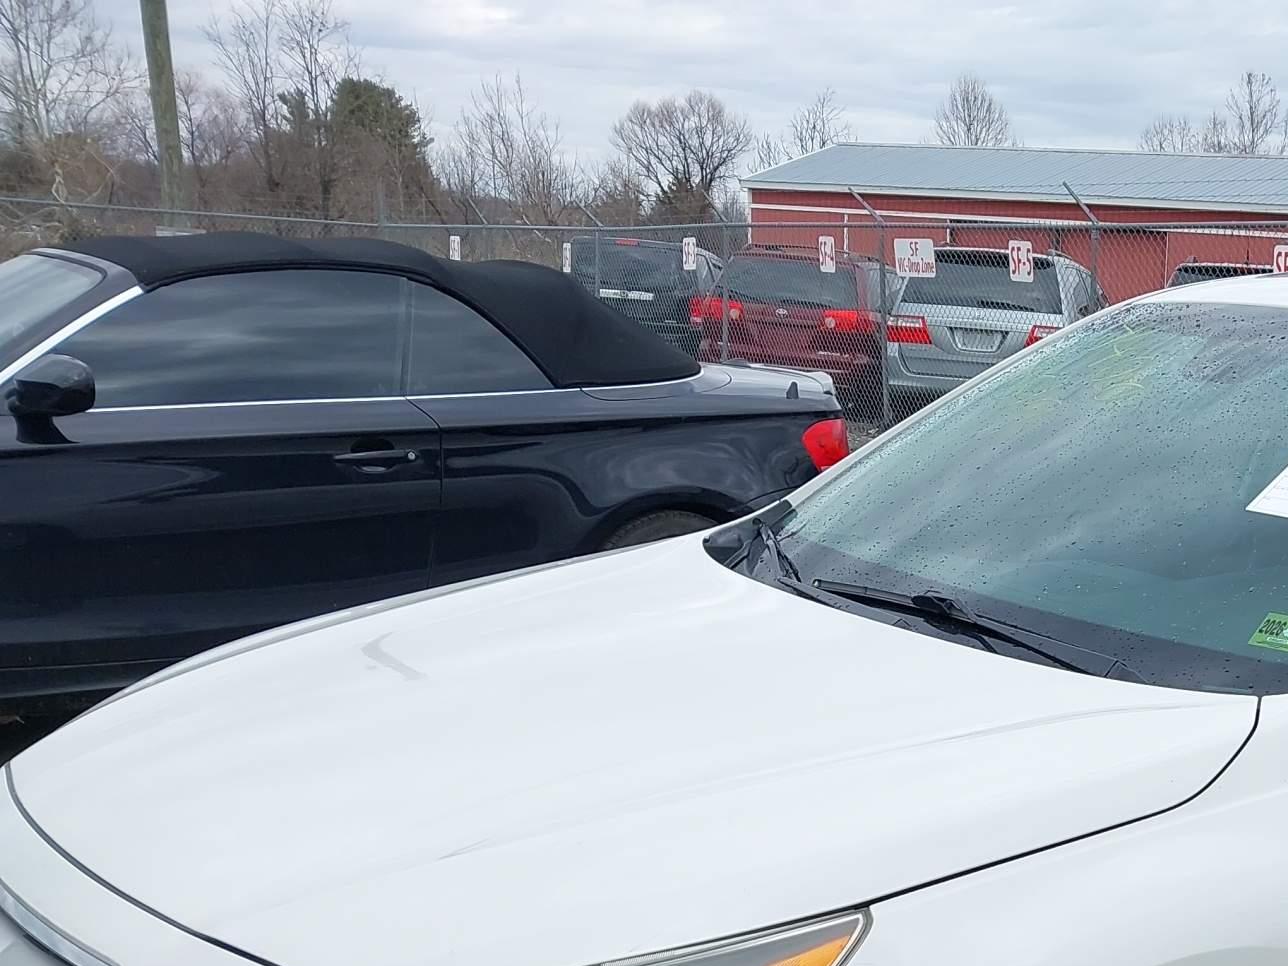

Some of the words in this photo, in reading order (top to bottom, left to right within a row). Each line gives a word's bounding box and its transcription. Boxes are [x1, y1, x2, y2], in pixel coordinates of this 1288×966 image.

[684, 242, 695, 264] SF-3
[820, 241, 834, 267] SF-4
[909, 241, 919, 257] SF
[921, 257, 935, 273] Zone
[1010, 246, 1032, 277] SF-5
